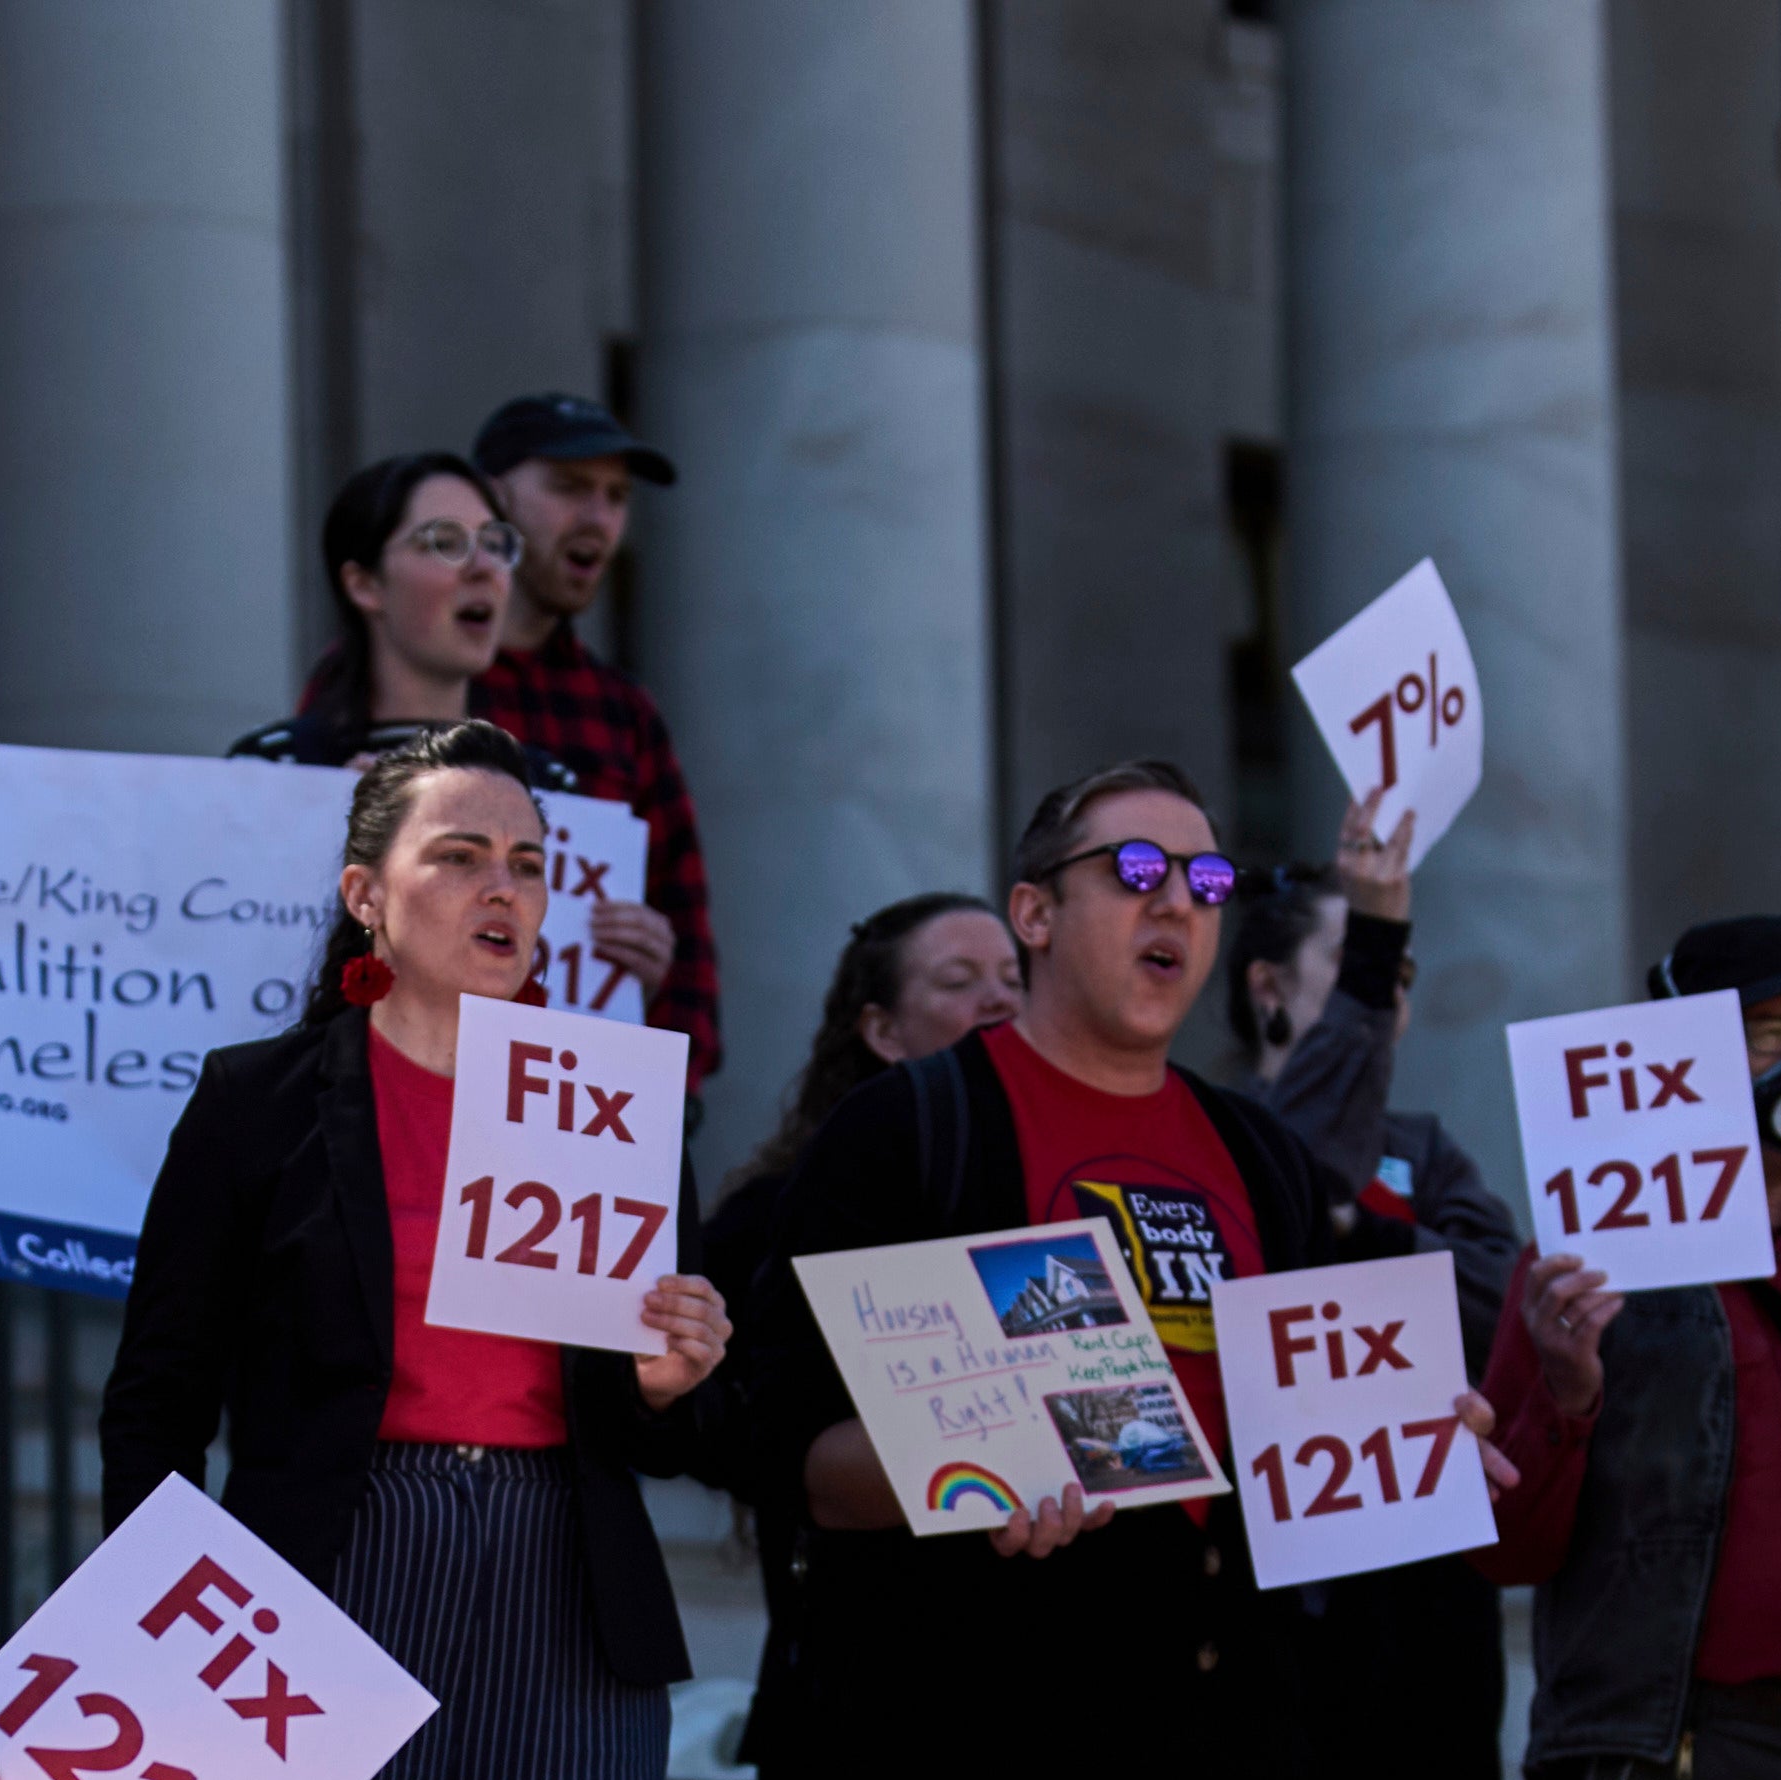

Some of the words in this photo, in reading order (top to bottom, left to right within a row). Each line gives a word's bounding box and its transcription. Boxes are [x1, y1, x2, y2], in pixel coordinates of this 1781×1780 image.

[1350, 652, 1464, 788] 7%
[542, 826, 612, 902] ix
[251, 978, 298, 1017] o
[506, 1040, 636, 1143] Fix
[1564, 1041, 1704, 1118] Fix
[459, 1175, 669, 1280] 1217
[1128, 1192, 1207, 1226] Every
[1545, 1145, 1749, 1235] 1217
[1138, 1219, 1215, 1250] body
[1151, 1250, 1225, 1300] IN
[852, 1280, 964, 1342] Housing
[1268, 1301, 1414, 1388] Fix
[1251, 1415, 1464, 1524] 1217
[137, 1553, 327, 1763] Fix
